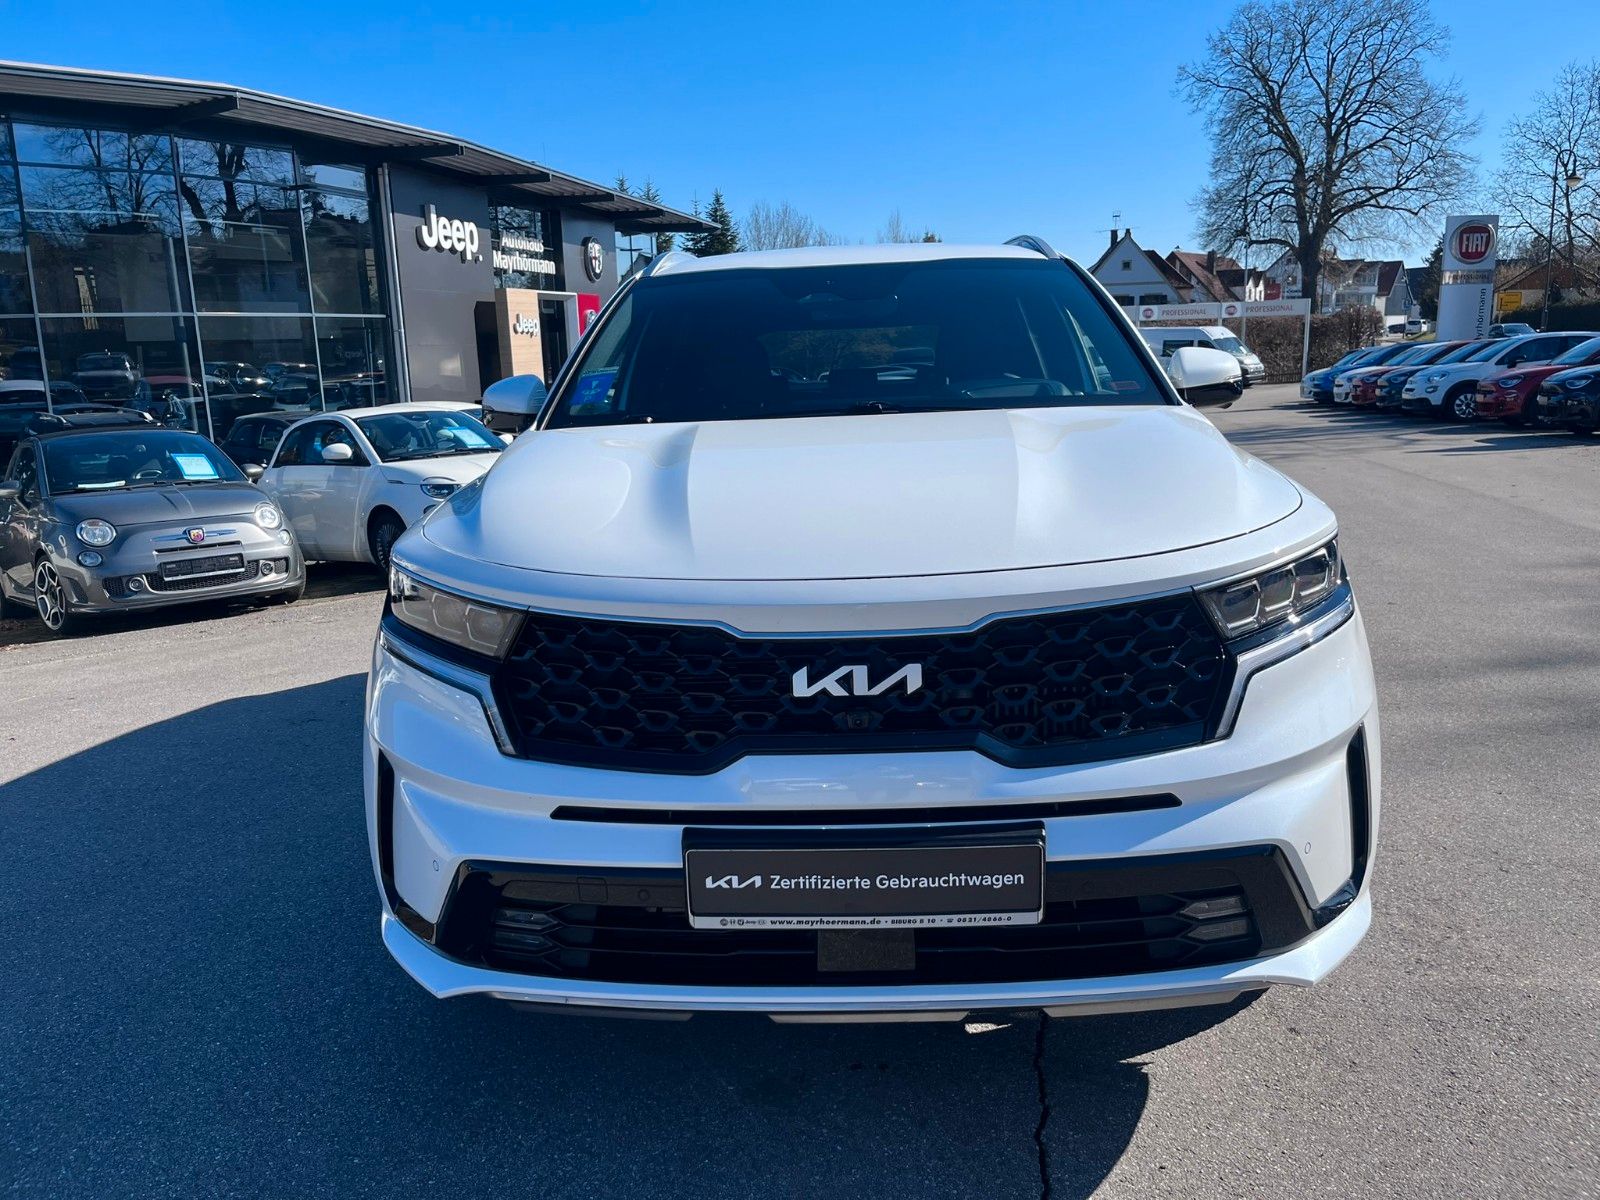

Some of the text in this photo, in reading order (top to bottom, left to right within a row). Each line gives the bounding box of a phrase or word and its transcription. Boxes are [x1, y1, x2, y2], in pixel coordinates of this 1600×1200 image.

[420, 204, 479, 261] Jeep
[501, 231, 545, 252] Autohaus
[1462, 232, 1489, 253] FIAT
[493, 250, 556, 275] Mayrhörmann
[1161, 308, 1207, 316] PROFESSIONAL
[1241, 304, 1294, 314] PROFESSIONAL
[1475, 288, 1487, 338] yrhörmann
[514, 313, 540, 337] Jeep
[792, 663, 923, 697] KIA
[705, 871, 1025, 892] KIA Zertifizierte Gebrauchtwagen
[770, 917, 882, 926] www.mayrhoermann.de
